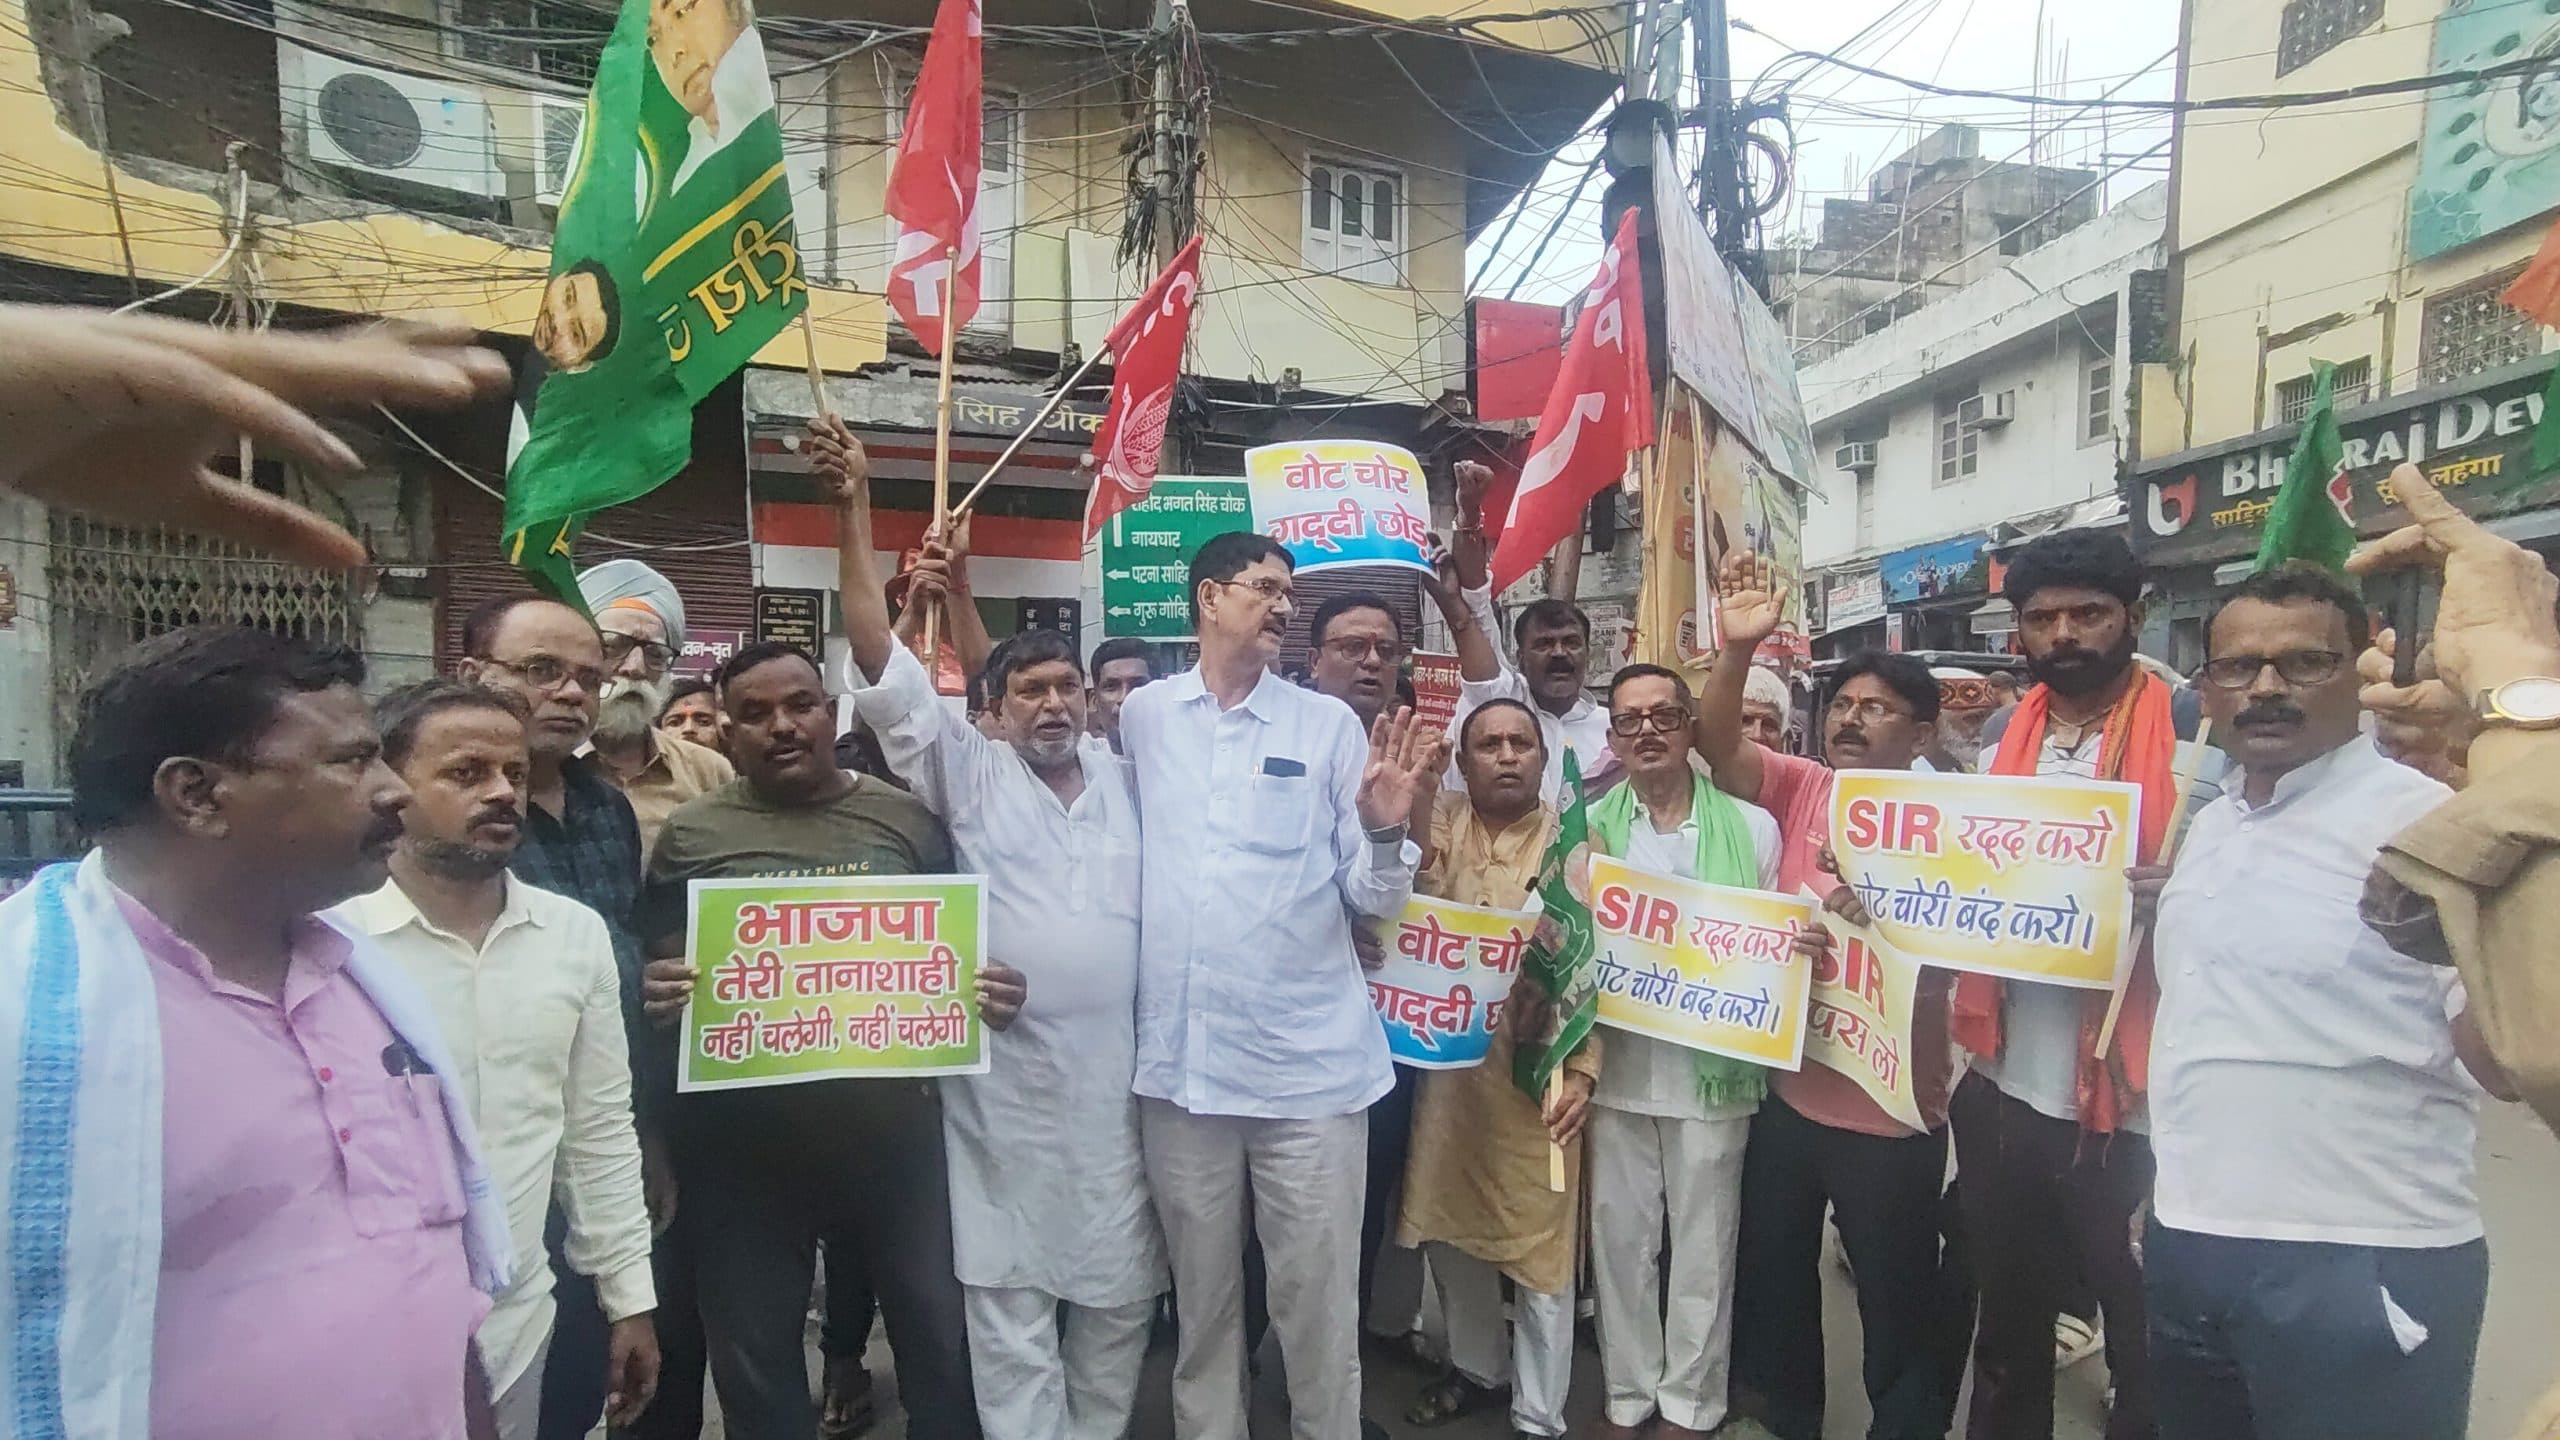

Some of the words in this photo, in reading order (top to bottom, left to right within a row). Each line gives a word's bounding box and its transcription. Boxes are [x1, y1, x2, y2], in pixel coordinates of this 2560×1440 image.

[1163, 495, 1194, 513] भगत
[1194, 489, 1219, 513] सिंह
[1219, 489, 1246, 513] चौक
[1284, 453, 1347, 490] वोट
[1353, 454, 1409, 494] चोर
[1131, 531, 1181, 548] गायघाट
[1268, 497, 1365, 551] गद्दी
[1373, 502, 1428, 558] छोड़
[1131, 565, 1160, 584] पटना
[1846, 800, 1941, 853] SIR
[1958, 815, 2031, 870] रद्द
[2036, 810, 2113, 863] करो
[752, 860, 870, 880] EVERYTHING
[739, 900, 941, 946] भाजपा
[1596, 886, 1679, 945] SIR
[1689, 914, 1742, 964] रद्द
[1743, 919, 1799, 963] करो
[1894, 877, 1953, 928] चोरी
[1955, 888, 2005, 940] बंद
[1398, 914, 1472, 970] वोट
[715, 951, 784, 1000] तेरी
[794, 945, 958, 995] तानाशाही
[1631, 962, 1679, 1006] चोरी
[1680, 977, 1718, 1021] बंद
[703, 1010, 761, 1060] नहीं
[762, 1005, 838, 1054] चलेगी,
[849, 1003, 896, 1050] नहीं
[897, 1002, 966, 1047] चलेगी
[1872, 1034, 1900, 1092] लो
